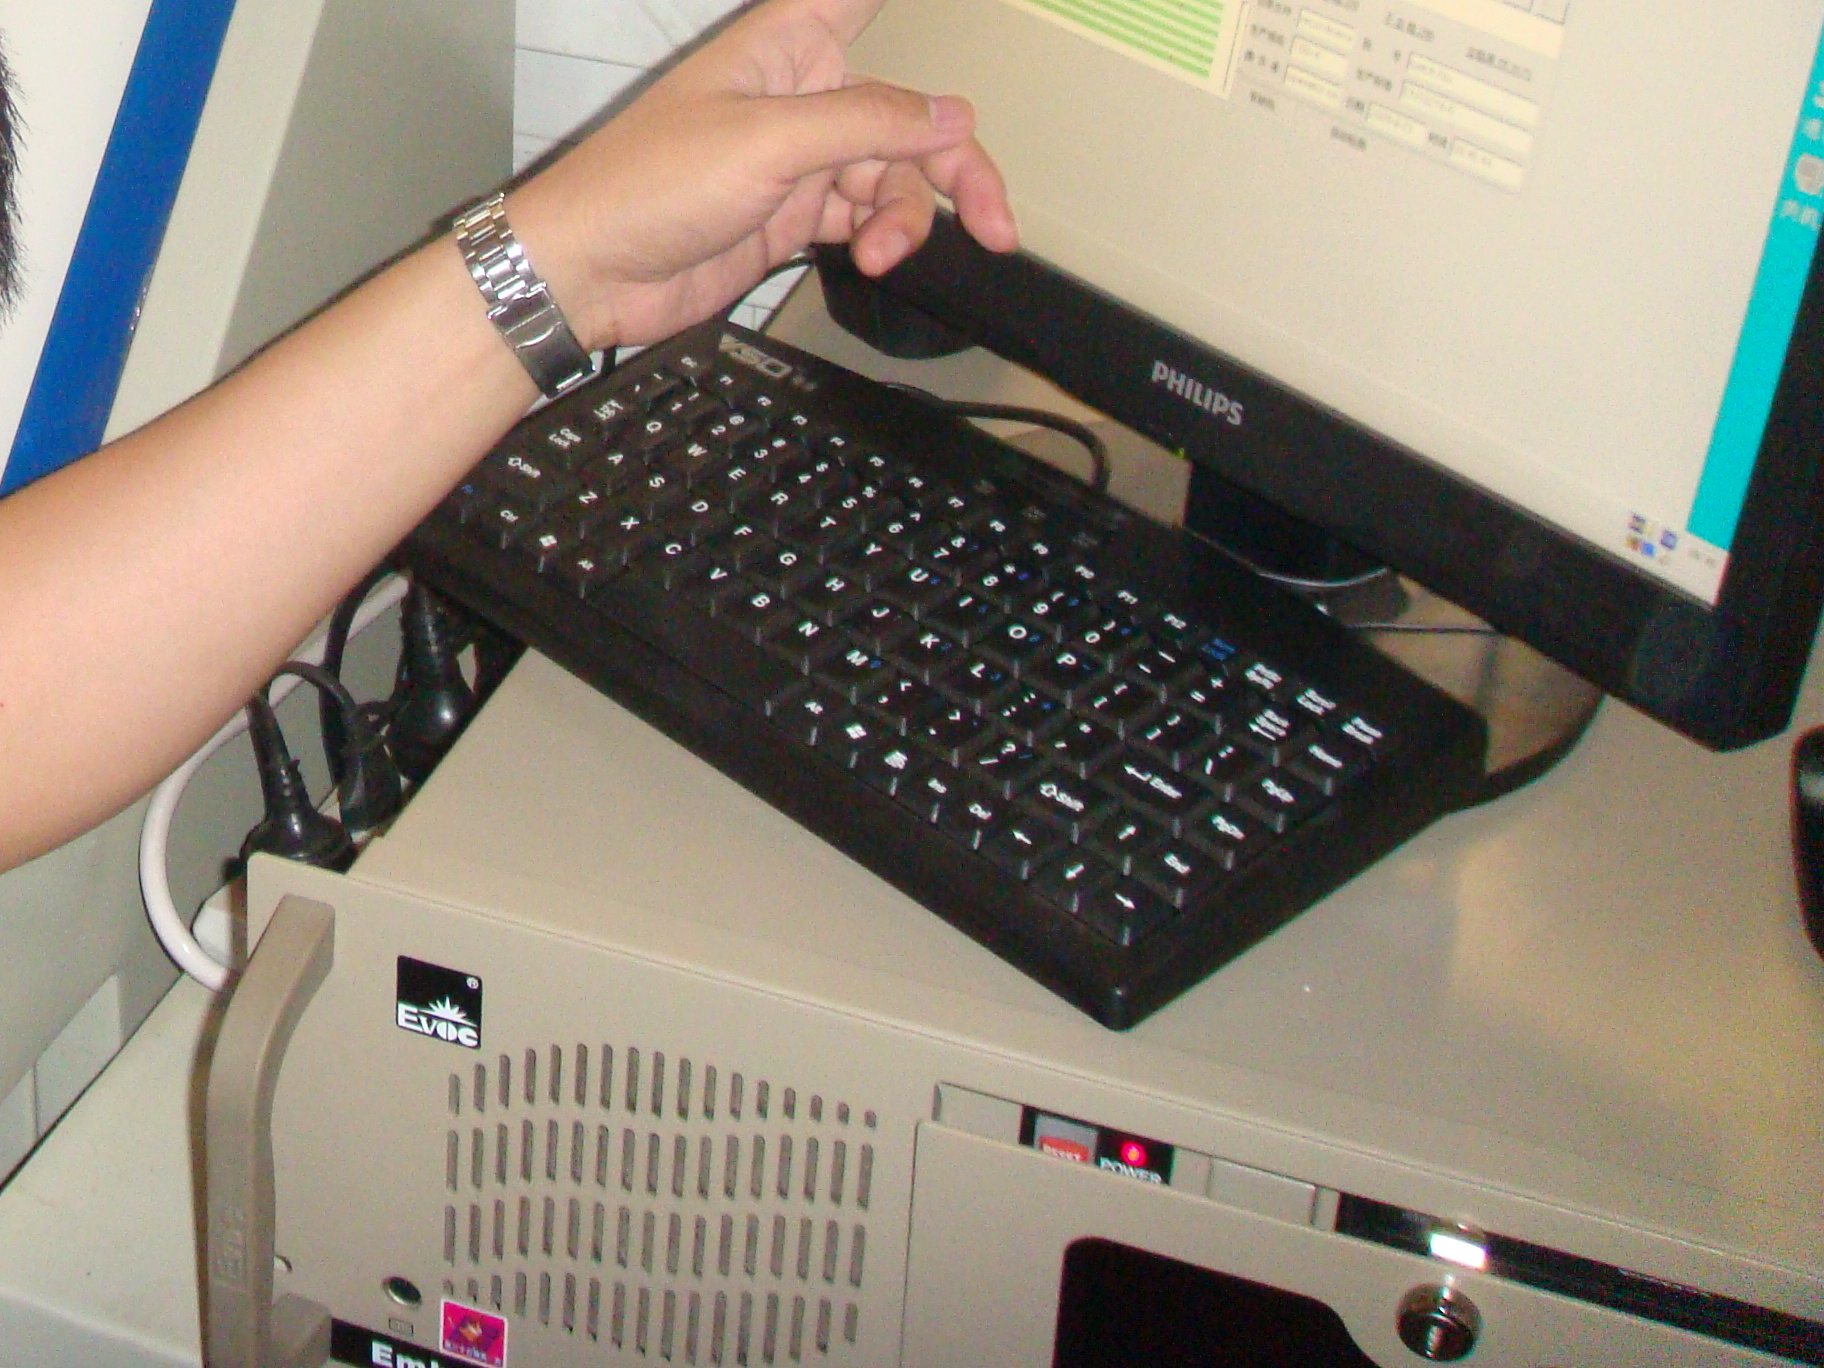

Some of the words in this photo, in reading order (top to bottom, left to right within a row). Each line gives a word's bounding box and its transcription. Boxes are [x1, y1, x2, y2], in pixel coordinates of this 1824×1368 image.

[1151, 359, 1244, 426] PHILIPS
[645, 420, 663, 434] Q
[687, 443, 708, 458] W
[753, 448, 769, 459] 3
[607, 453, 624, 466] A
[728, 467, 747, 481] E
[648, 476, 666, 489] S
[578, 490, 598, 505] Z
[770, 491, 789, 506] R
[690, 500, 709, 513] D
[620, 516, 640, 531] X
[820, 516, 837, 528] T
[888, 522, 904, 534] 6
[734, 525, 753, 536] F
[664, 542, 682, 555] C
[865, 542, 883, 555] Y
[934, 547, 950, 559] 7
[779, 552, 797, 566] G
[710, 567, 728, 580] V
[909, 568, 929, 583] U
[825, 577, 845, 592] H
[751, 593, 771, 608] B
[871, 608, 890, 618] J
[1032, 602, 1049, 615] 9
[798, 621, 820, 637] N
[919, 633, 940, 649] K
[846, 649, 869, 667] M
[1056, 652, 1077, 666] P
[970, 663, 986, 678] L
